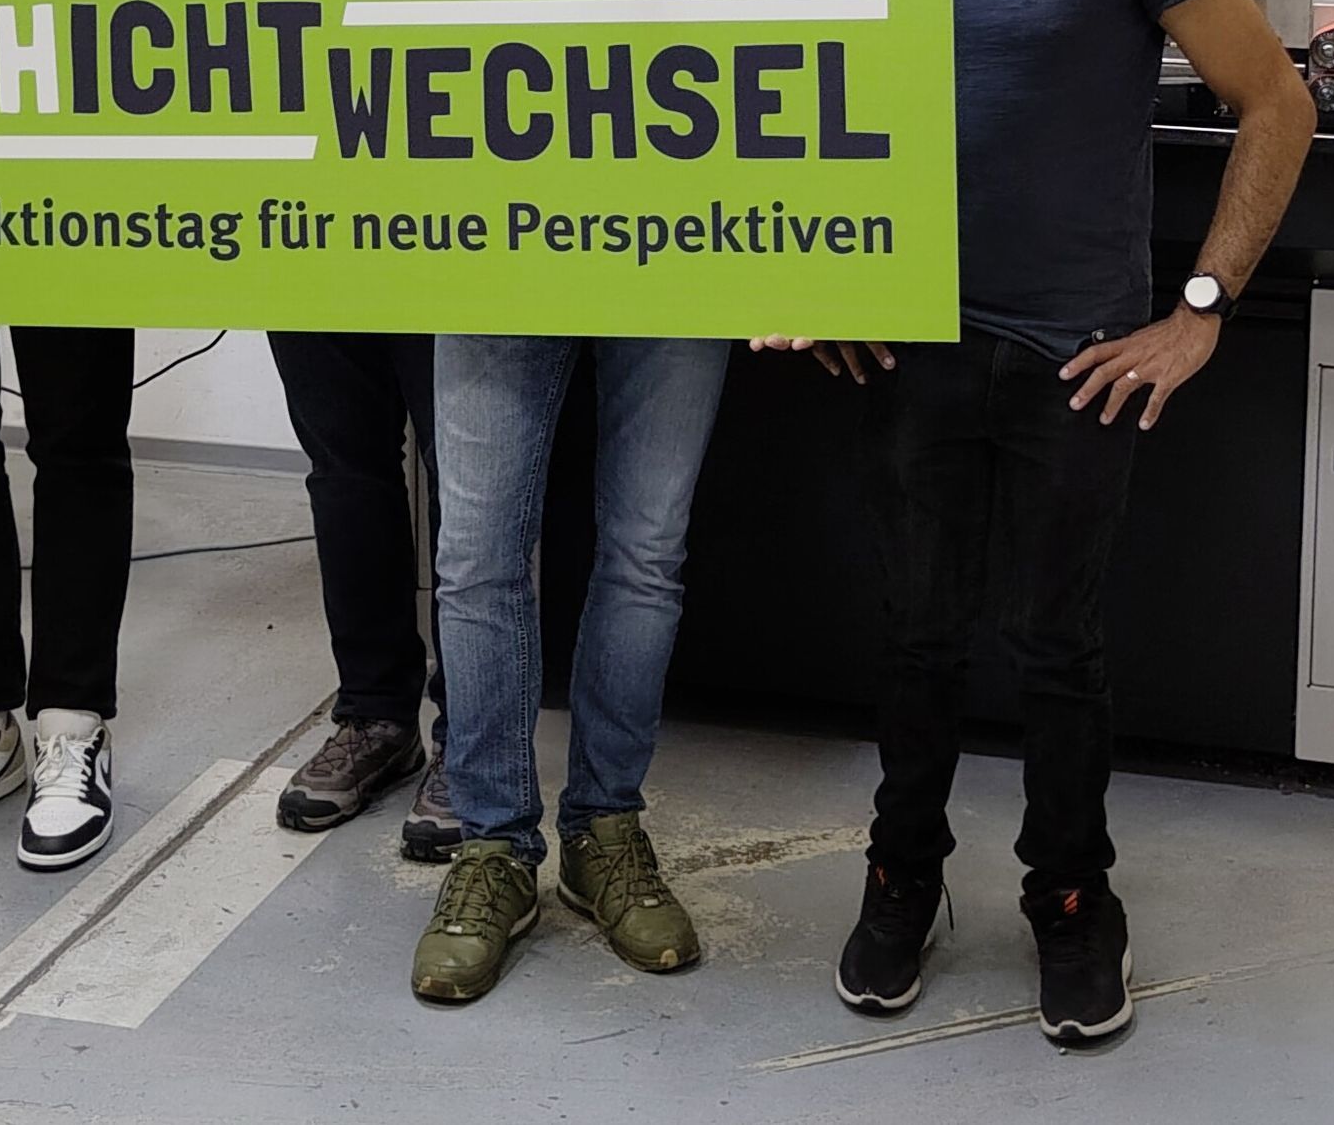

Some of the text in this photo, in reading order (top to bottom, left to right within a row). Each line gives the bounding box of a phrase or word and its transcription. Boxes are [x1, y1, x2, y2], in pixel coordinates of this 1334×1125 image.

[327, 41, 892, 162] WECHSEL
[258, 198, 335, 250] für
[352, 213, 488, 252] neue
[508, 200, 893, 267] Perspektiven
